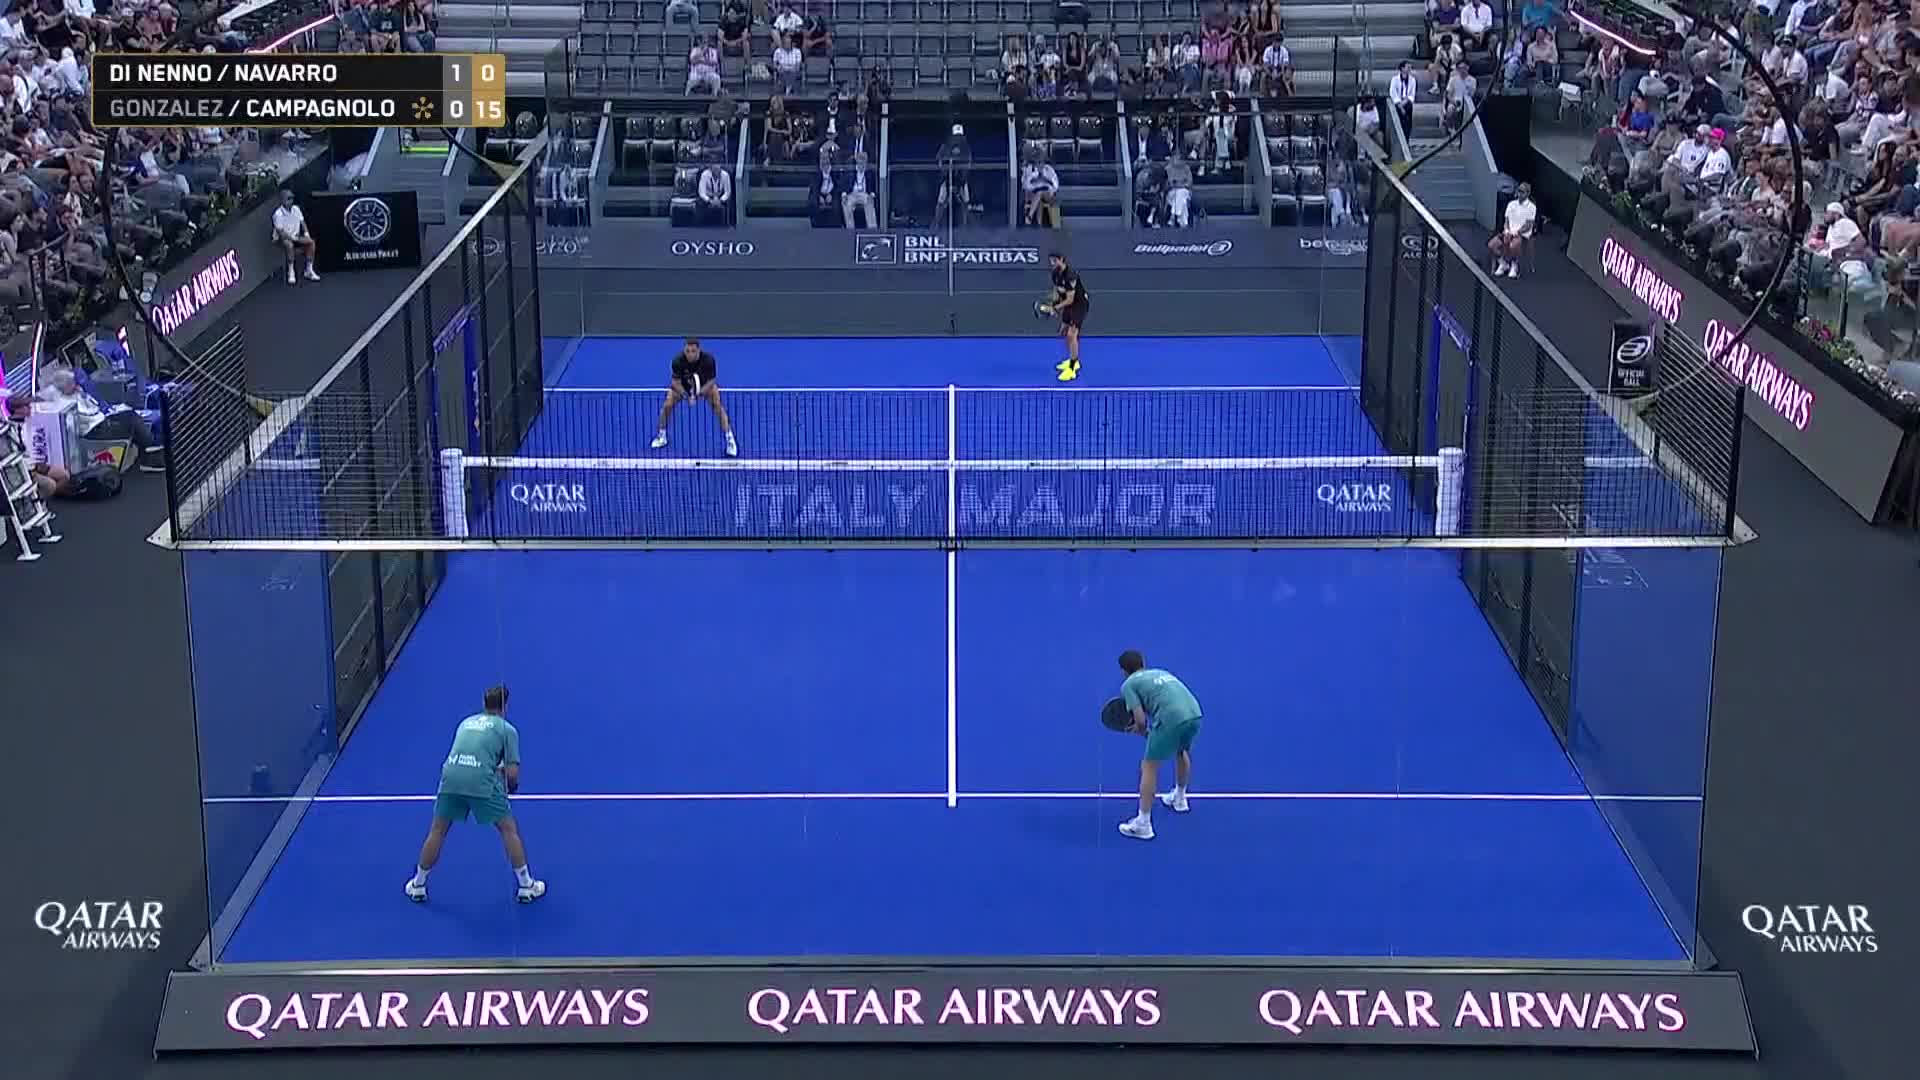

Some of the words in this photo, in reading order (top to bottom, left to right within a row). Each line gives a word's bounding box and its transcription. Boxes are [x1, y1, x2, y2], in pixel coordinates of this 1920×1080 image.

[671, 240, 754, 256] OYSHO
[904, 235, 945, 247] BNL
[904, 252, 947, 263] BNP
[952, 251, 1040, 263] PARIBAS
[192, 249, 240, 311] AIRWAYS
[1602, 238, 1635, 288] QATAR
[1631, 263, 1682, 325] AIRWAYS
[1745, 353, 1813, 430] AIRWAYS
[510, 484, 586, 505] QATAR
[530, 501, 587, 513] AIRWAYS
[734, 484, 929, 528] ITALY
[958, 483, 1216, 528] MAJOR
[1317, 483, 1392, 505] QATAR
[1335, 501, 1392, 513] AIRWAYS
[35, 900, 163, 936] QATAR
[1742, 904, 1874, 939] QATAR
[61, 931, 161, 949] AIRWAYS
[1780, 935, 1879, 953] AIRWAYS
[226, 991, 409, 1040] QATAR
[422, 988, 650, 1029] AIRWAYS
[747, 987, 925, 1033] QATAR
[937, 988, 1161, 1026] AIRWAYS
[1258, 989, 1441, 1034] QATAR
[1453, 989, 1688, 1032] AIRWAYS
